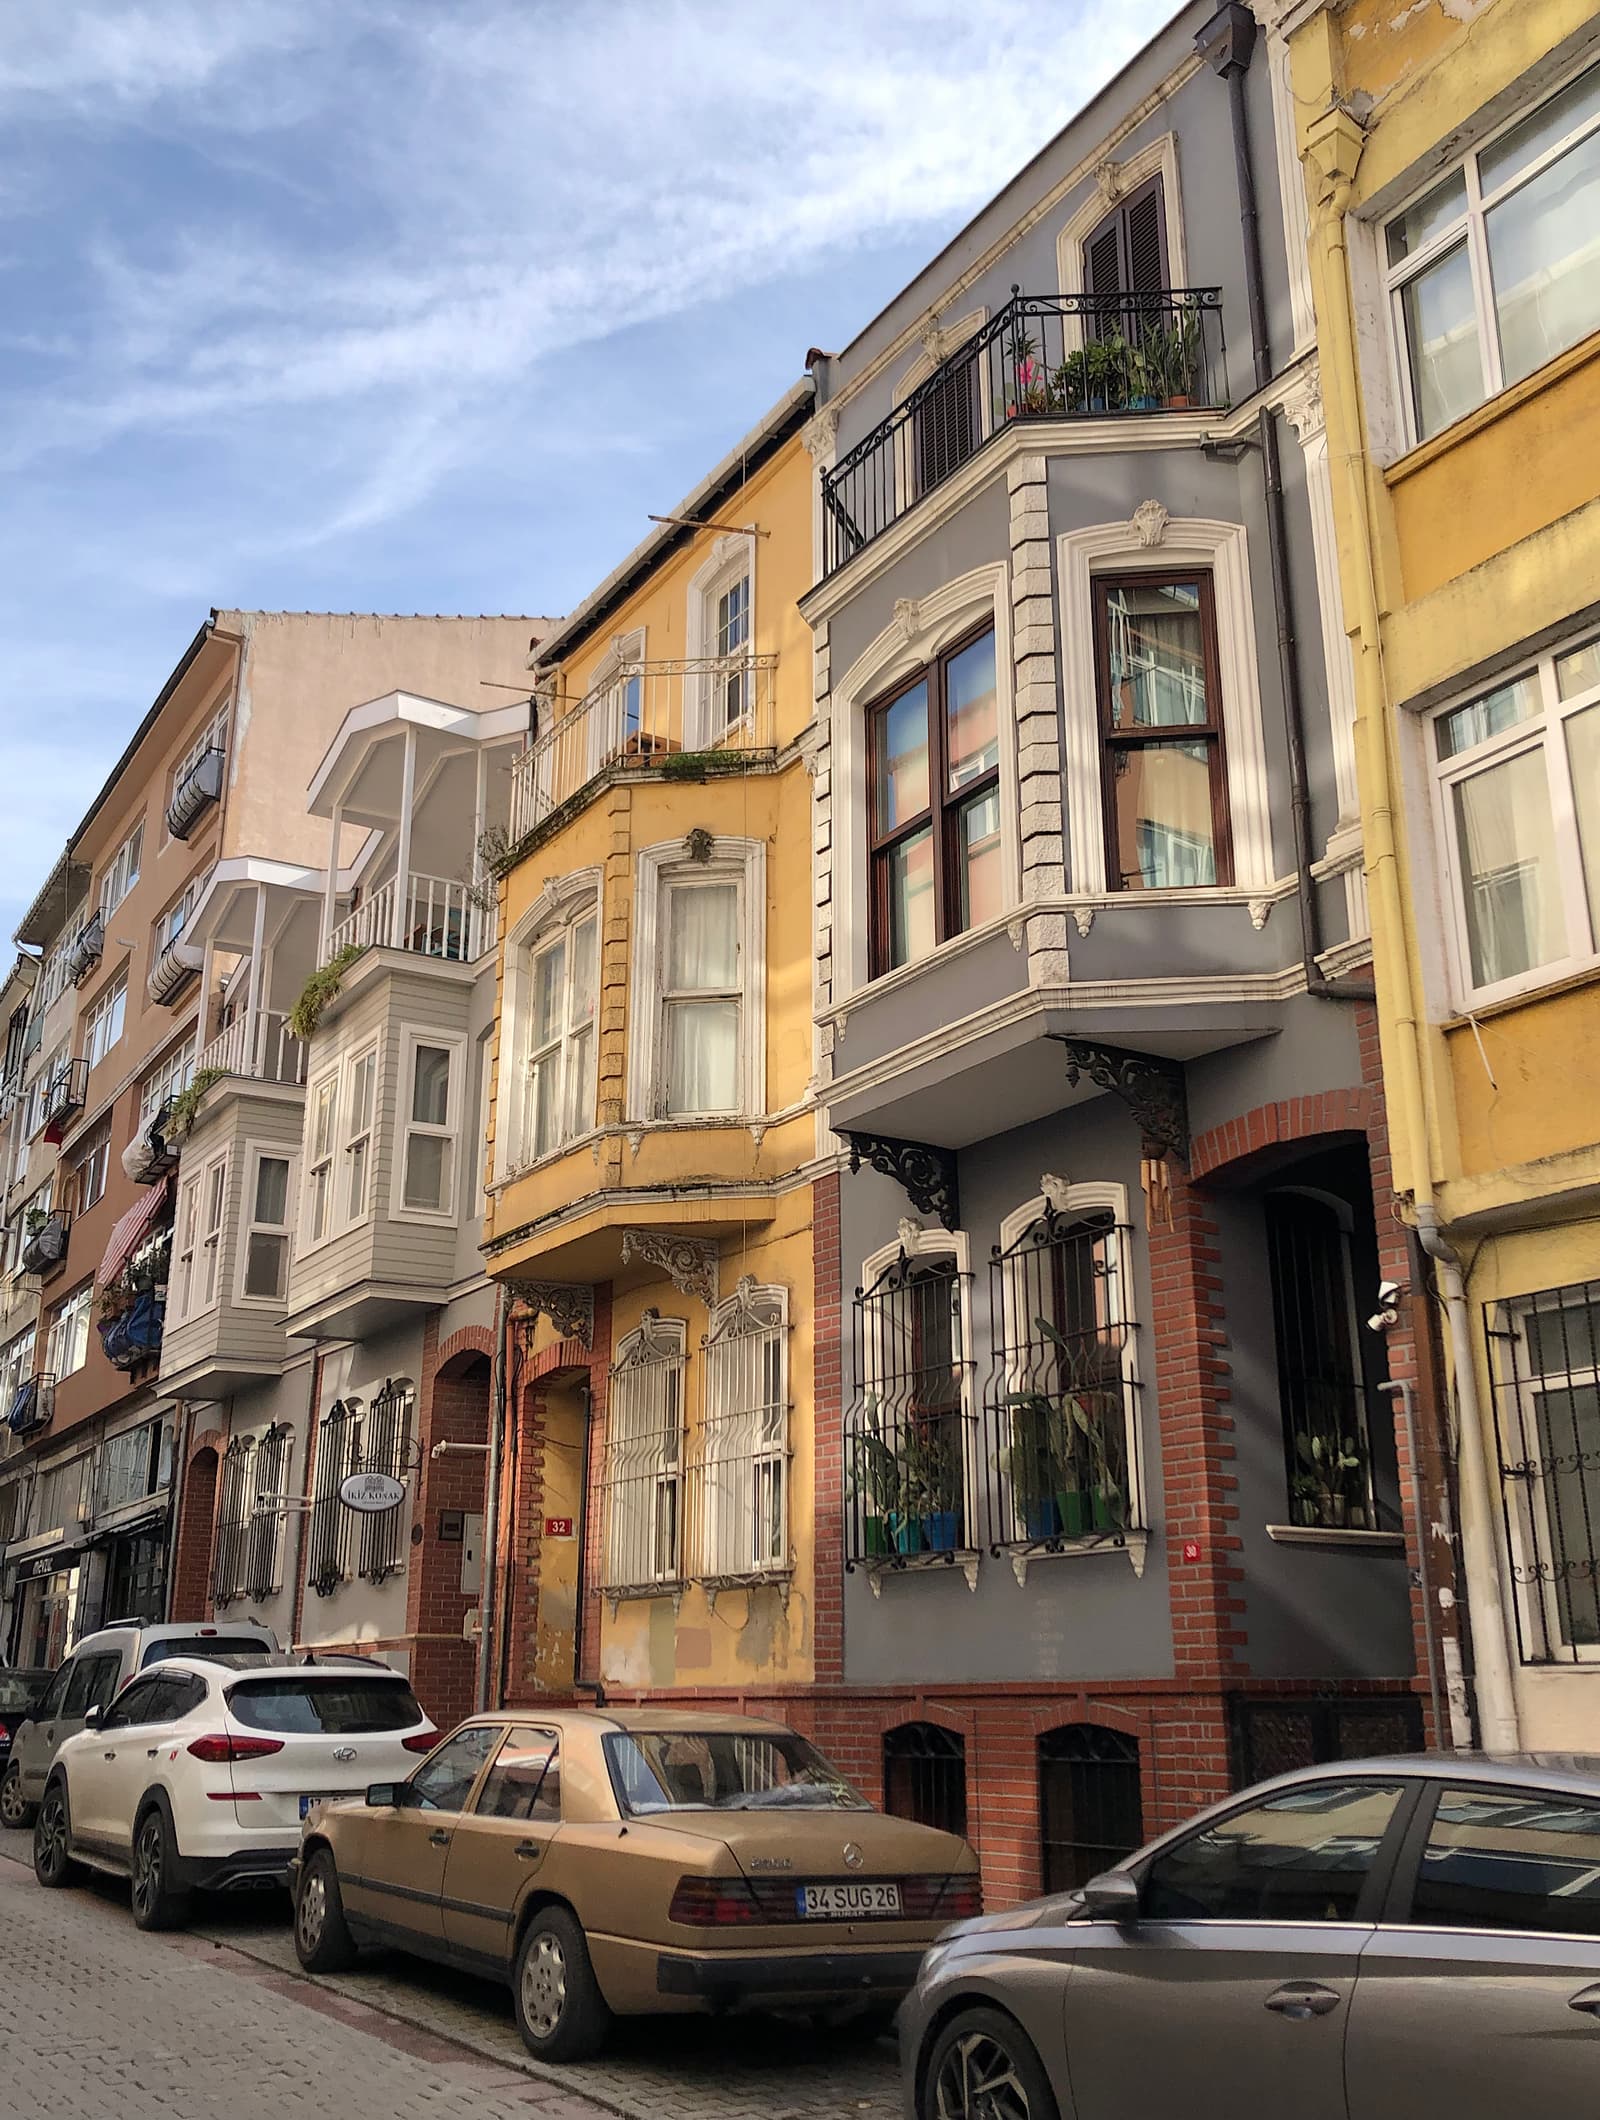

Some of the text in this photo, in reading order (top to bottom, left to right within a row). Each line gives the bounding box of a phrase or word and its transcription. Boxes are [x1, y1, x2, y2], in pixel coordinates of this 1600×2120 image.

[347, 1489, 368, 1501] İKİZ
[552, 1521, 566, 1533] 32
[807, 1886, 897, 1909] 34 SUG 26
